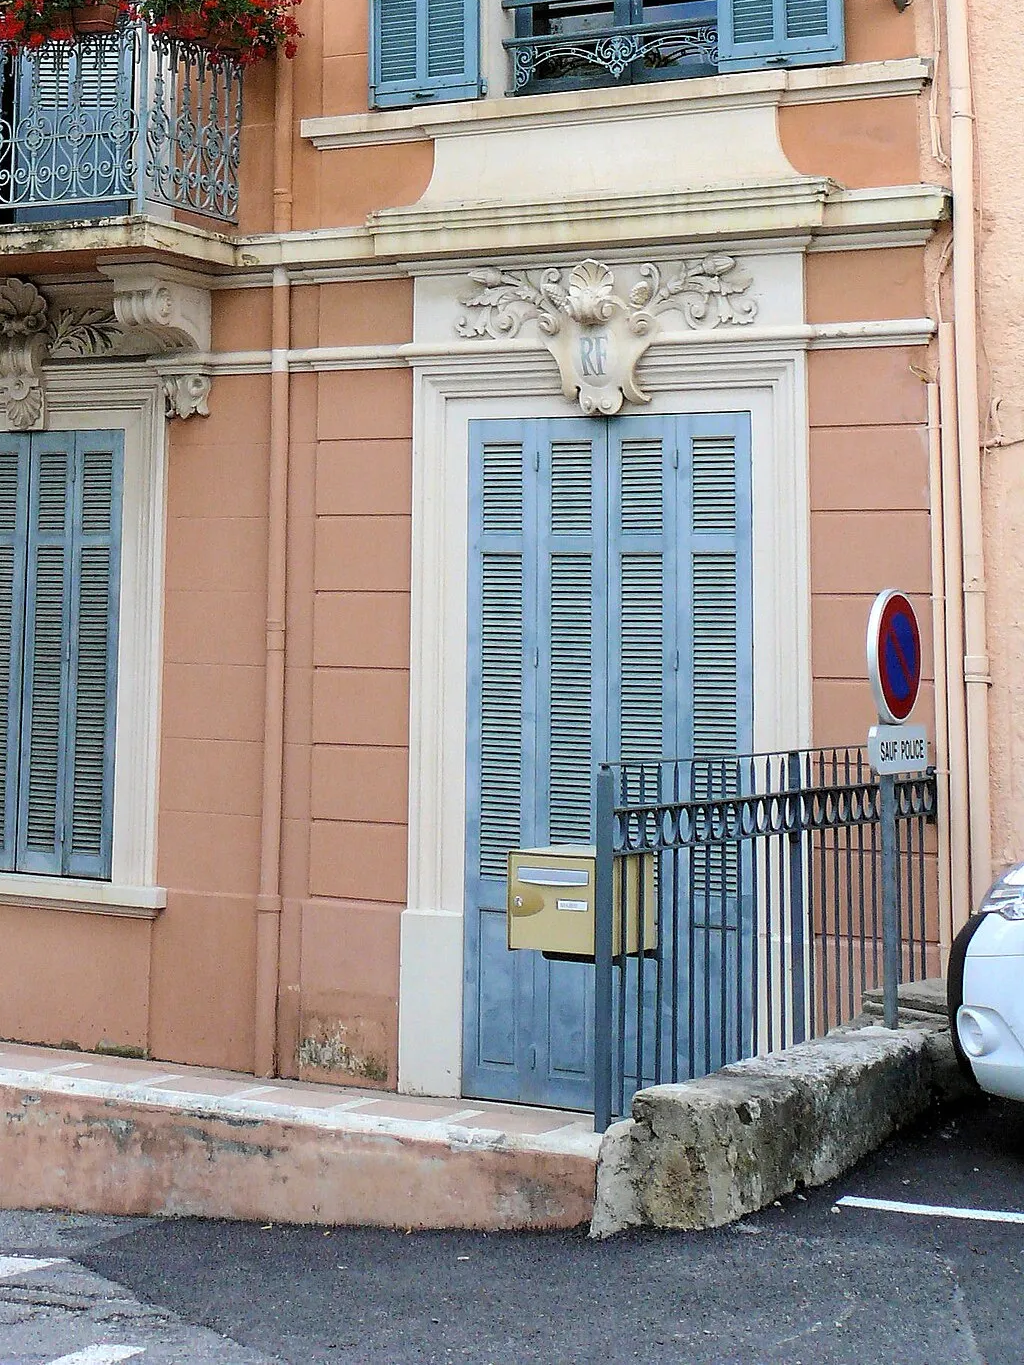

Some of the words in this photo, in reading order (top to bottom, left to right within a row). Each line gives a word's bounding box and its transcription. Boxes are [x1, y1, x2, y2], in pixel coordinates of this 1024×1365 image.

[580, 337, 608, 376] RF
[880, 740, 898, 762] SAUF
[901, 738, 925, 760] POLICE
